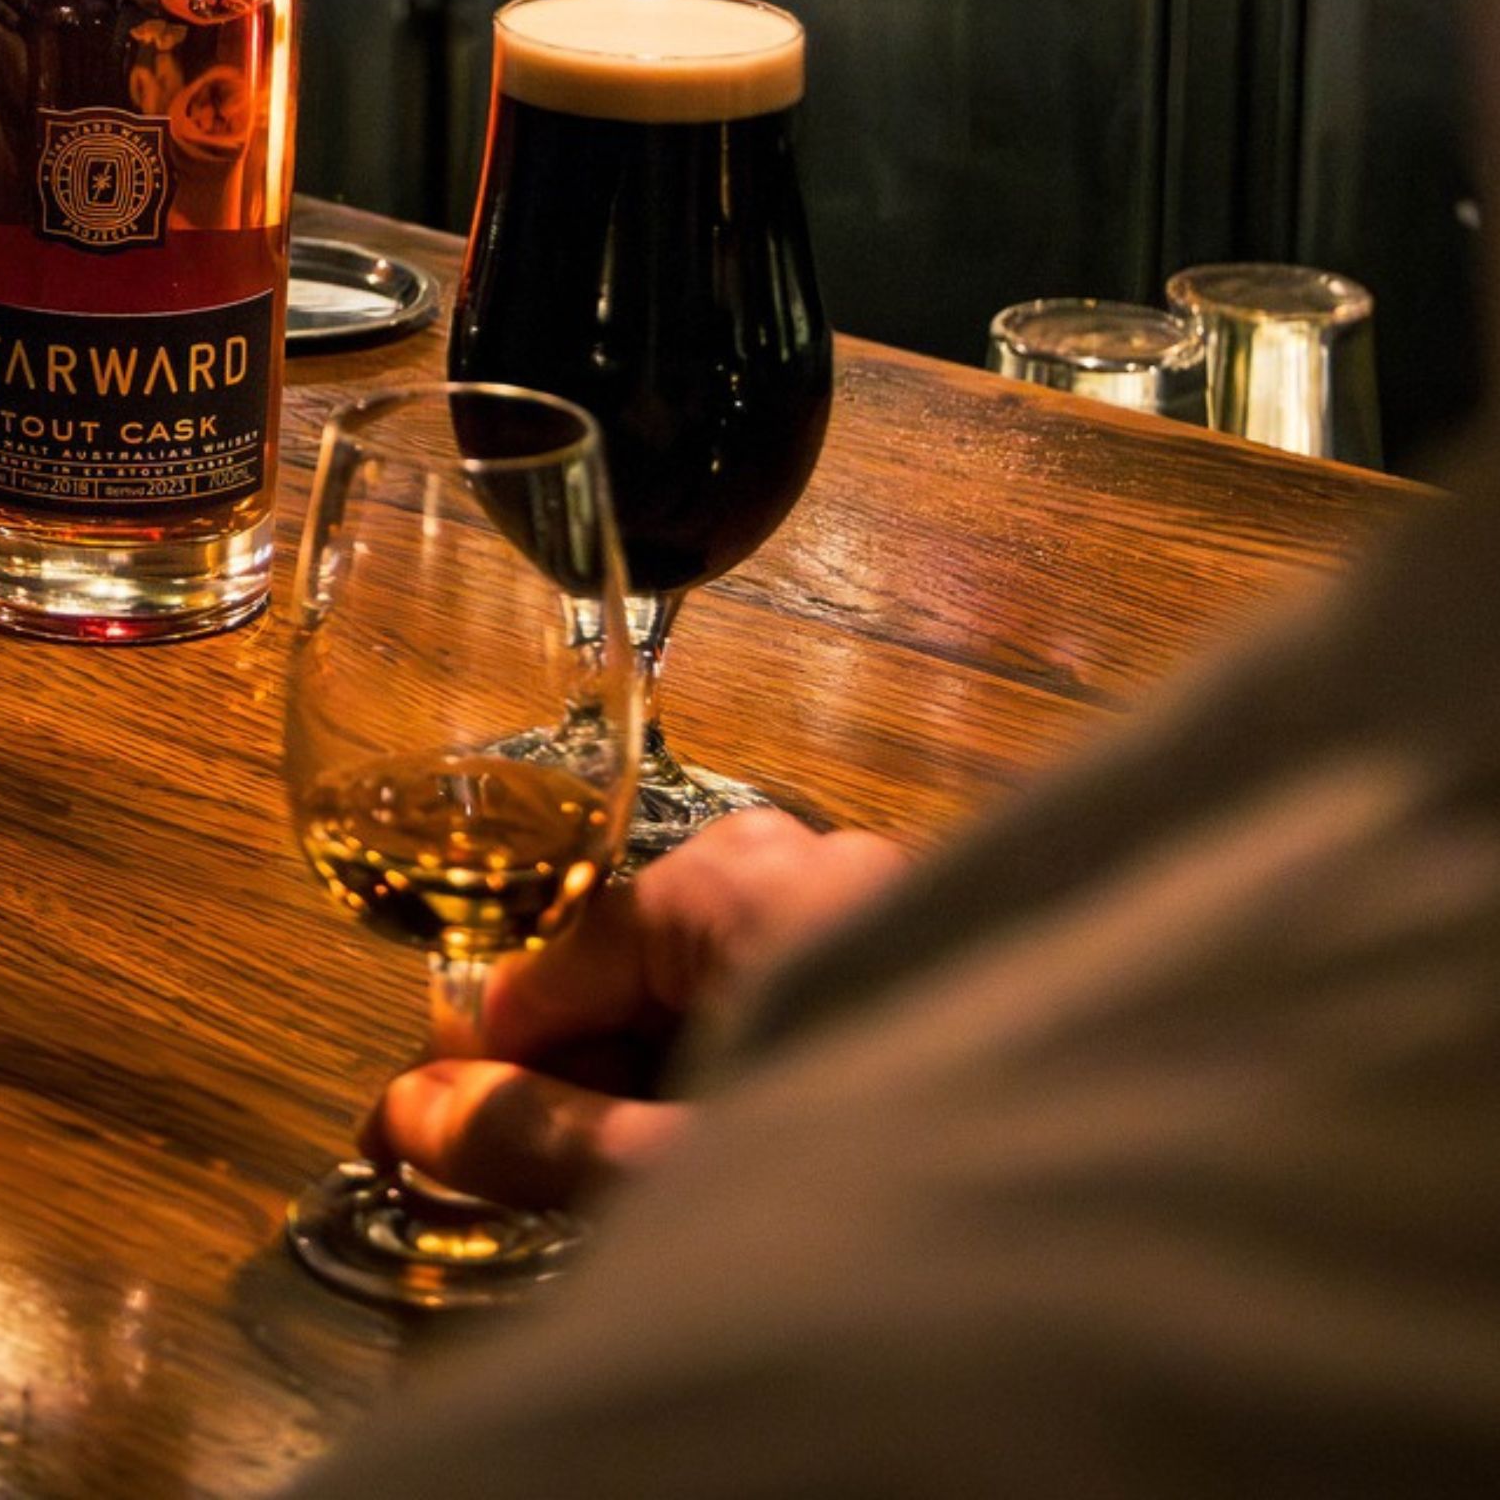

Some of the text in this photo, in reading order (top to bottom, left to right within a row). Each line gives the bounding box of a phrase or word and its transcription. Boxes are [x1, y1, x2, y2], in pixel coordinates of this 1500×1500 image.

[120, 414, 218, 444] CASK
[4, 440, 49, 456] MALT
[62, 447, 192, 461] AUSTRALIAN
[203, 430, 258, 454] WHISKY
[117, 466, 174, 477] STOUT
[146, 477, 187, 496] 2023
